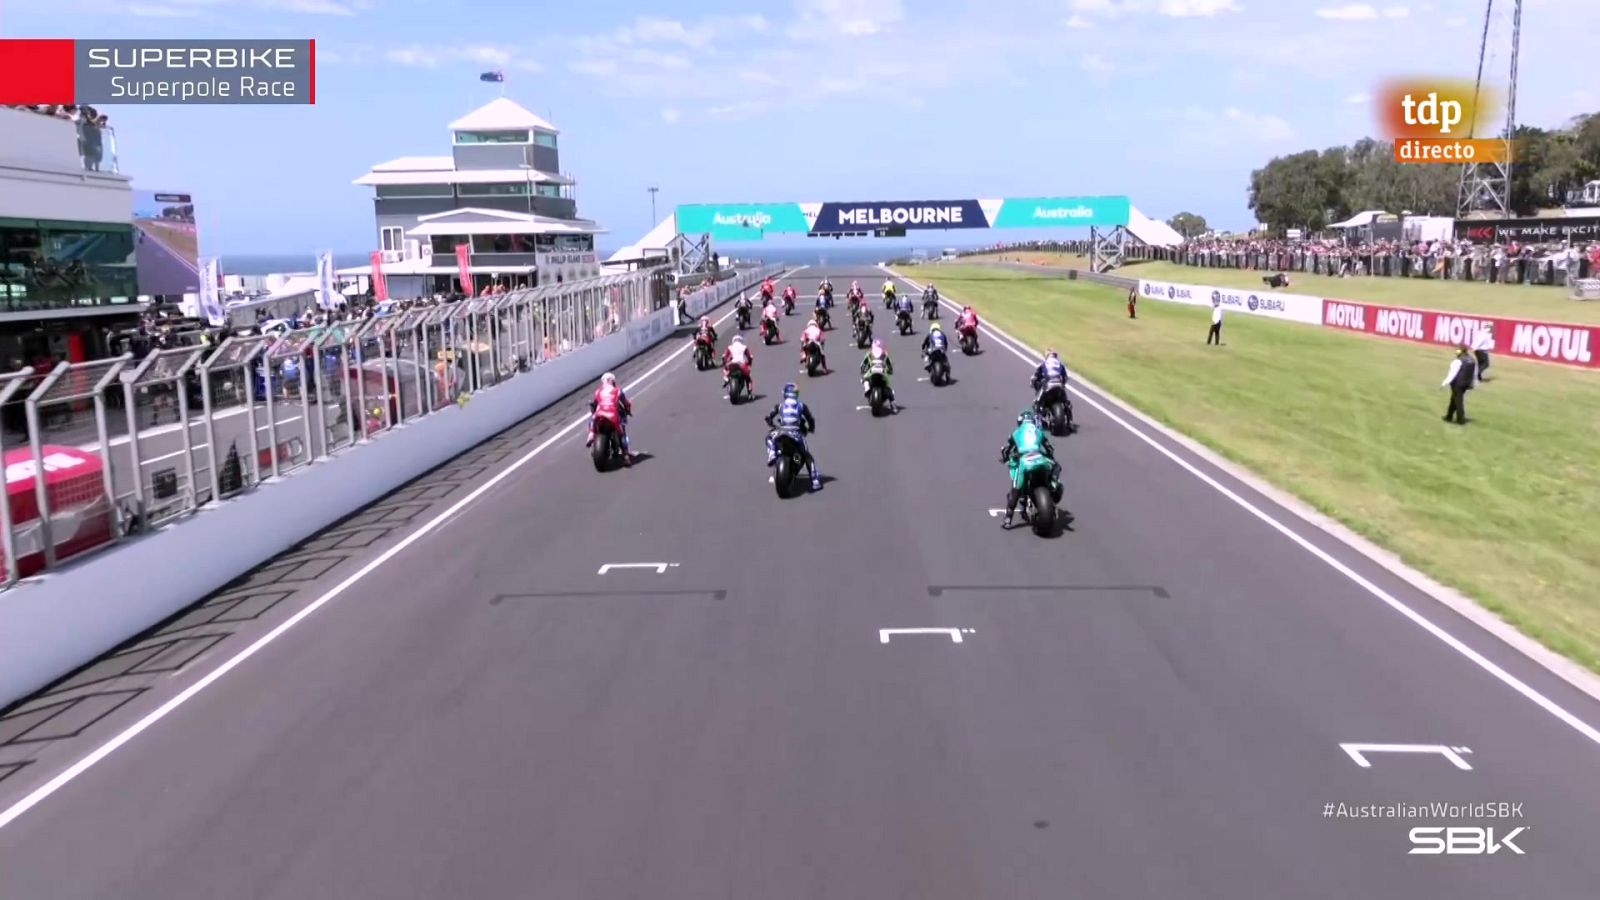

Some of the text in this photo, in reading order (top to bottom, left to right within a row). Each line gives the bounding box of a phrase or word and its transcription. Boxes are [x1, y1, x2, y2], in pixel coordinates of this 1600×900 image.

[838, 206, 964, 225] MELBOURNE
[1033, 205, 1094, 220] Australia
[1520, 226, 1557, 236] MAKE
[666, 274, 675, 282] 10
[1260, 299, 1286, 312] SUBARU
[1326, 302, 1365, 330] MOTUL
[1375, 308, 1424, 340] MOTUL
[1511, 323, 1592, 363] MOTUL
